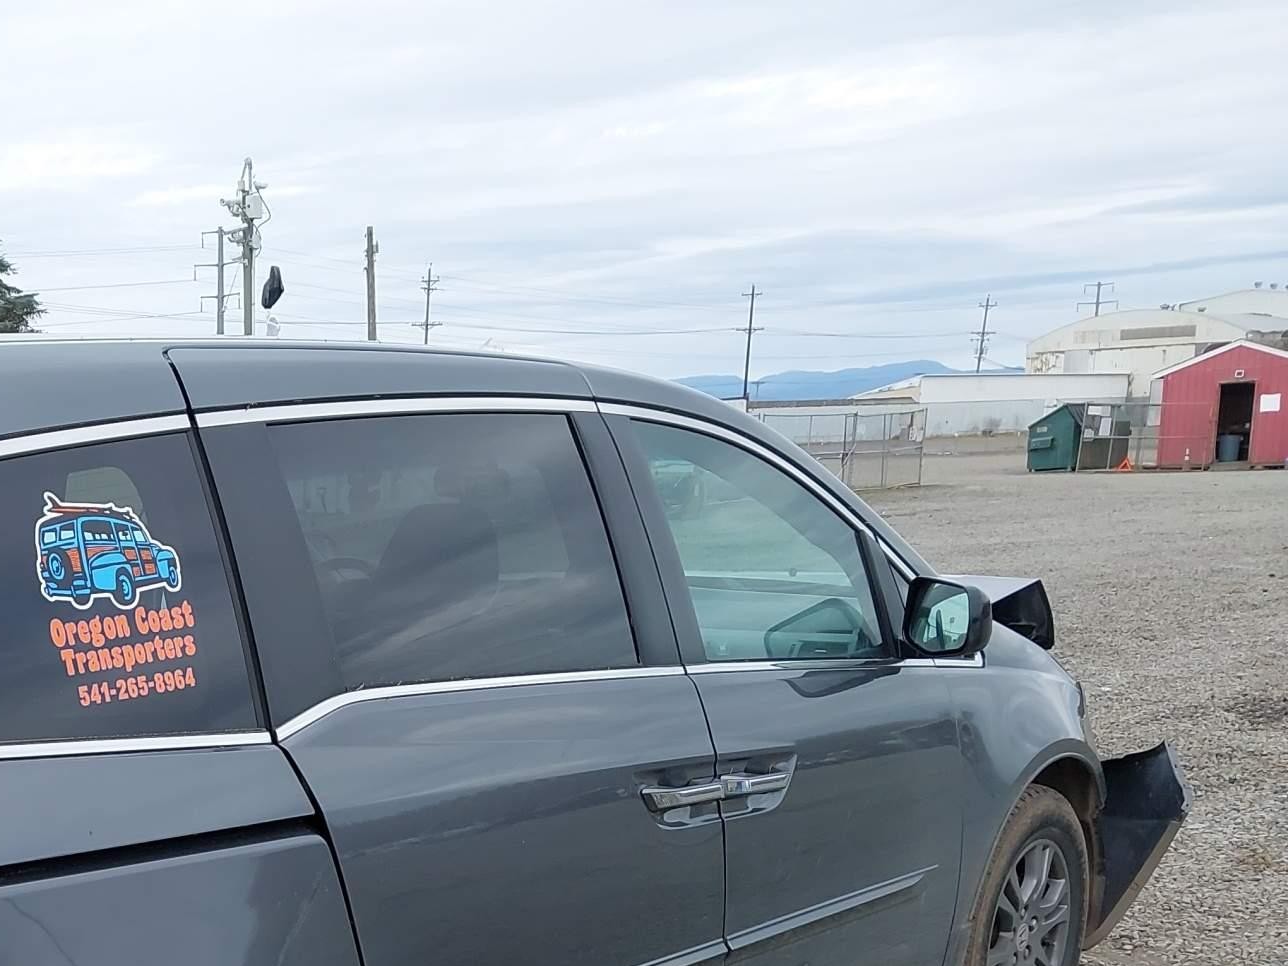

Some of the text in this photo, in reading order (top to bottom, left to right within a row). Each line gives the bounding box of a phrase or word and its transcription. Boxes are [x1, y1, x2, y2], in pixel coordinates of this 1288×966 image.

[49, 600, 194, 647] Oregon Coast
[60, 635, 196, 676] Transporters
[78, 667, 196, 706] 541-265-8964
